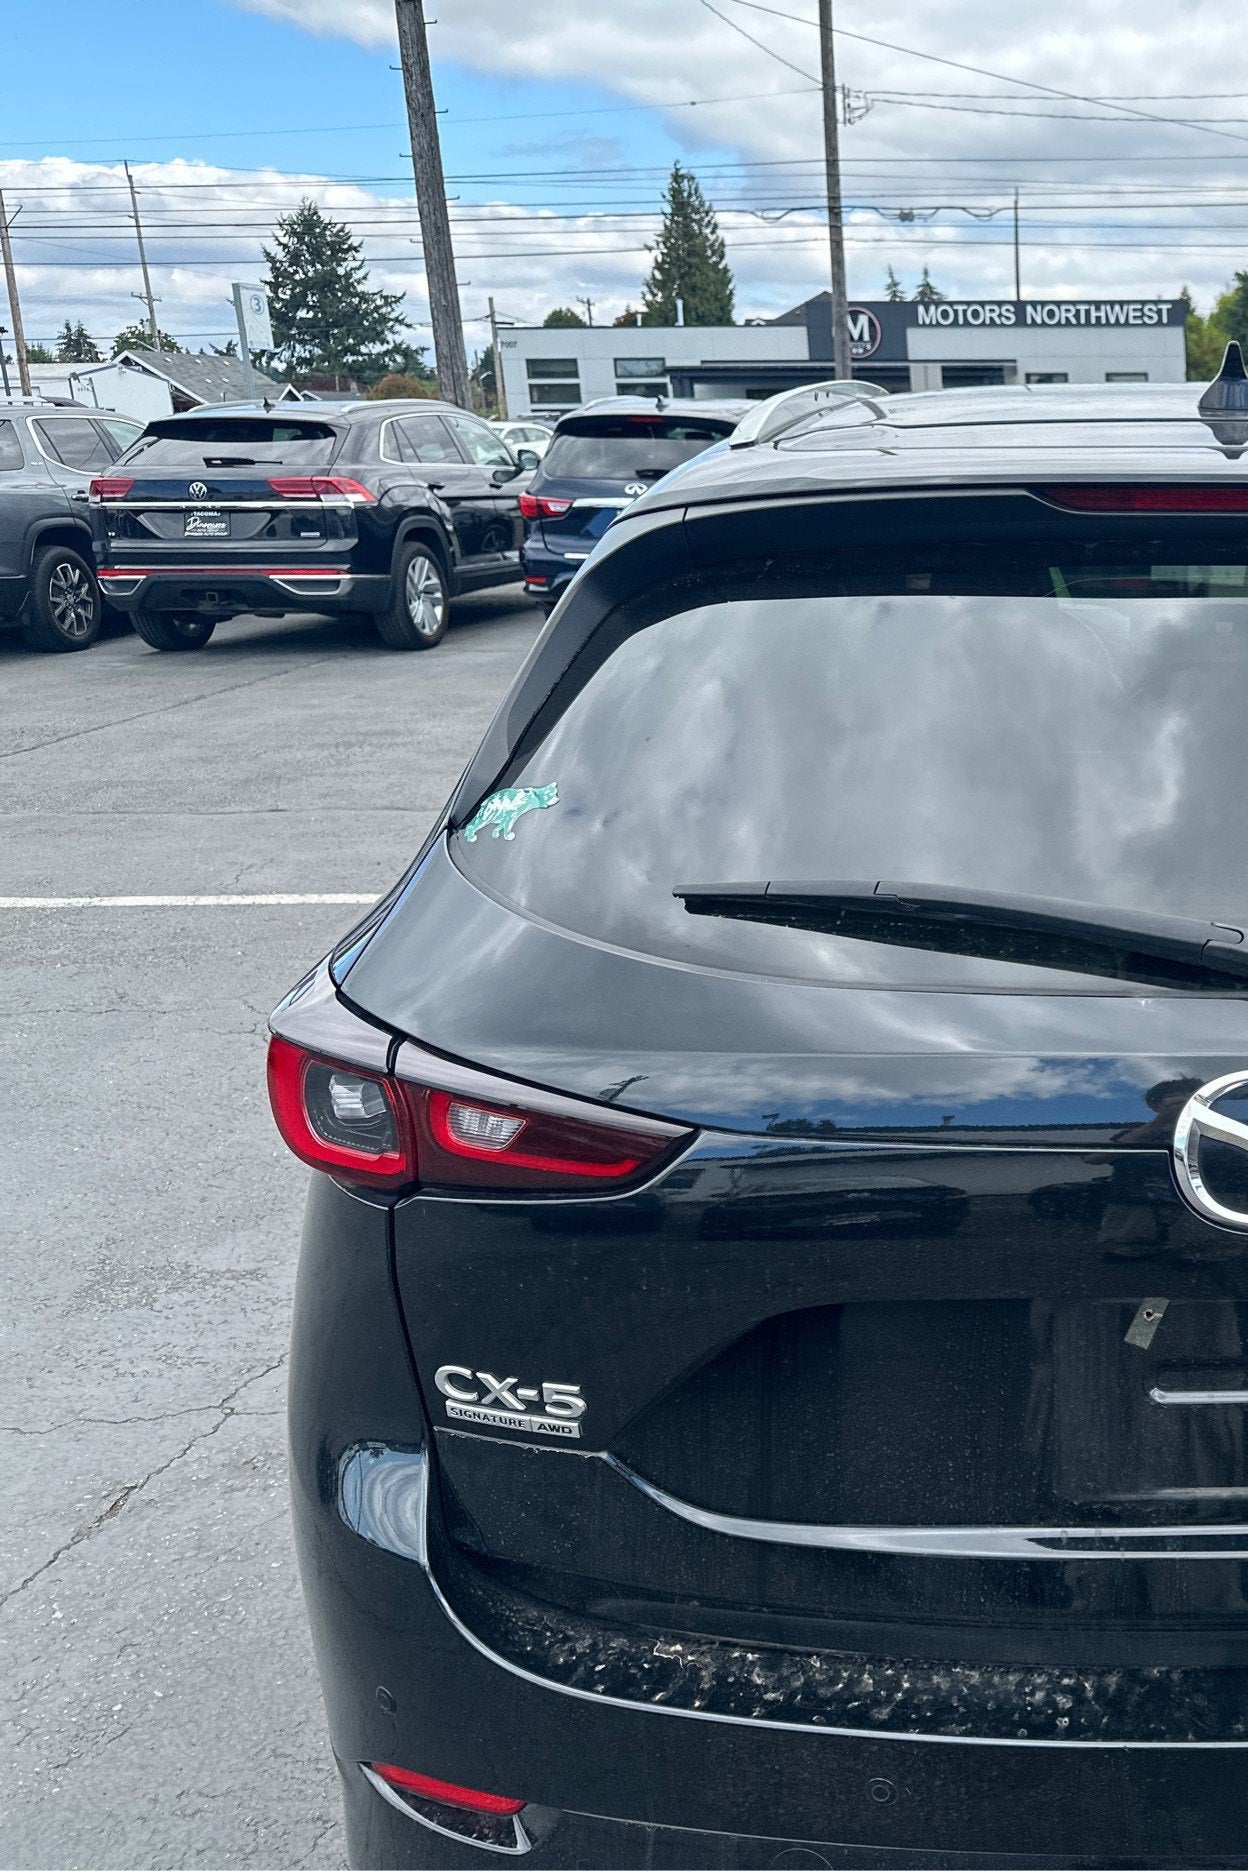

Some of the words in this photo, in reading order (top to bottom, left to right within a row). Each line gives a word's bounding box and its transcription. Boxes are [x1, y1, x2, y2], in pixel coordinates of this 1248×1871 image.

[253, 297, 262, 312] 3
[917, 303, 1016, 326] MOTORS
[1026, 303, 1173, 325] NORTHWEST
[846, 313, 870, 341] M
[434, 1365, 588, 1418] CX-5
[450, 1406, 526, 1428] SIGNATURE
[537, 1422, 573, 1435] AWD
